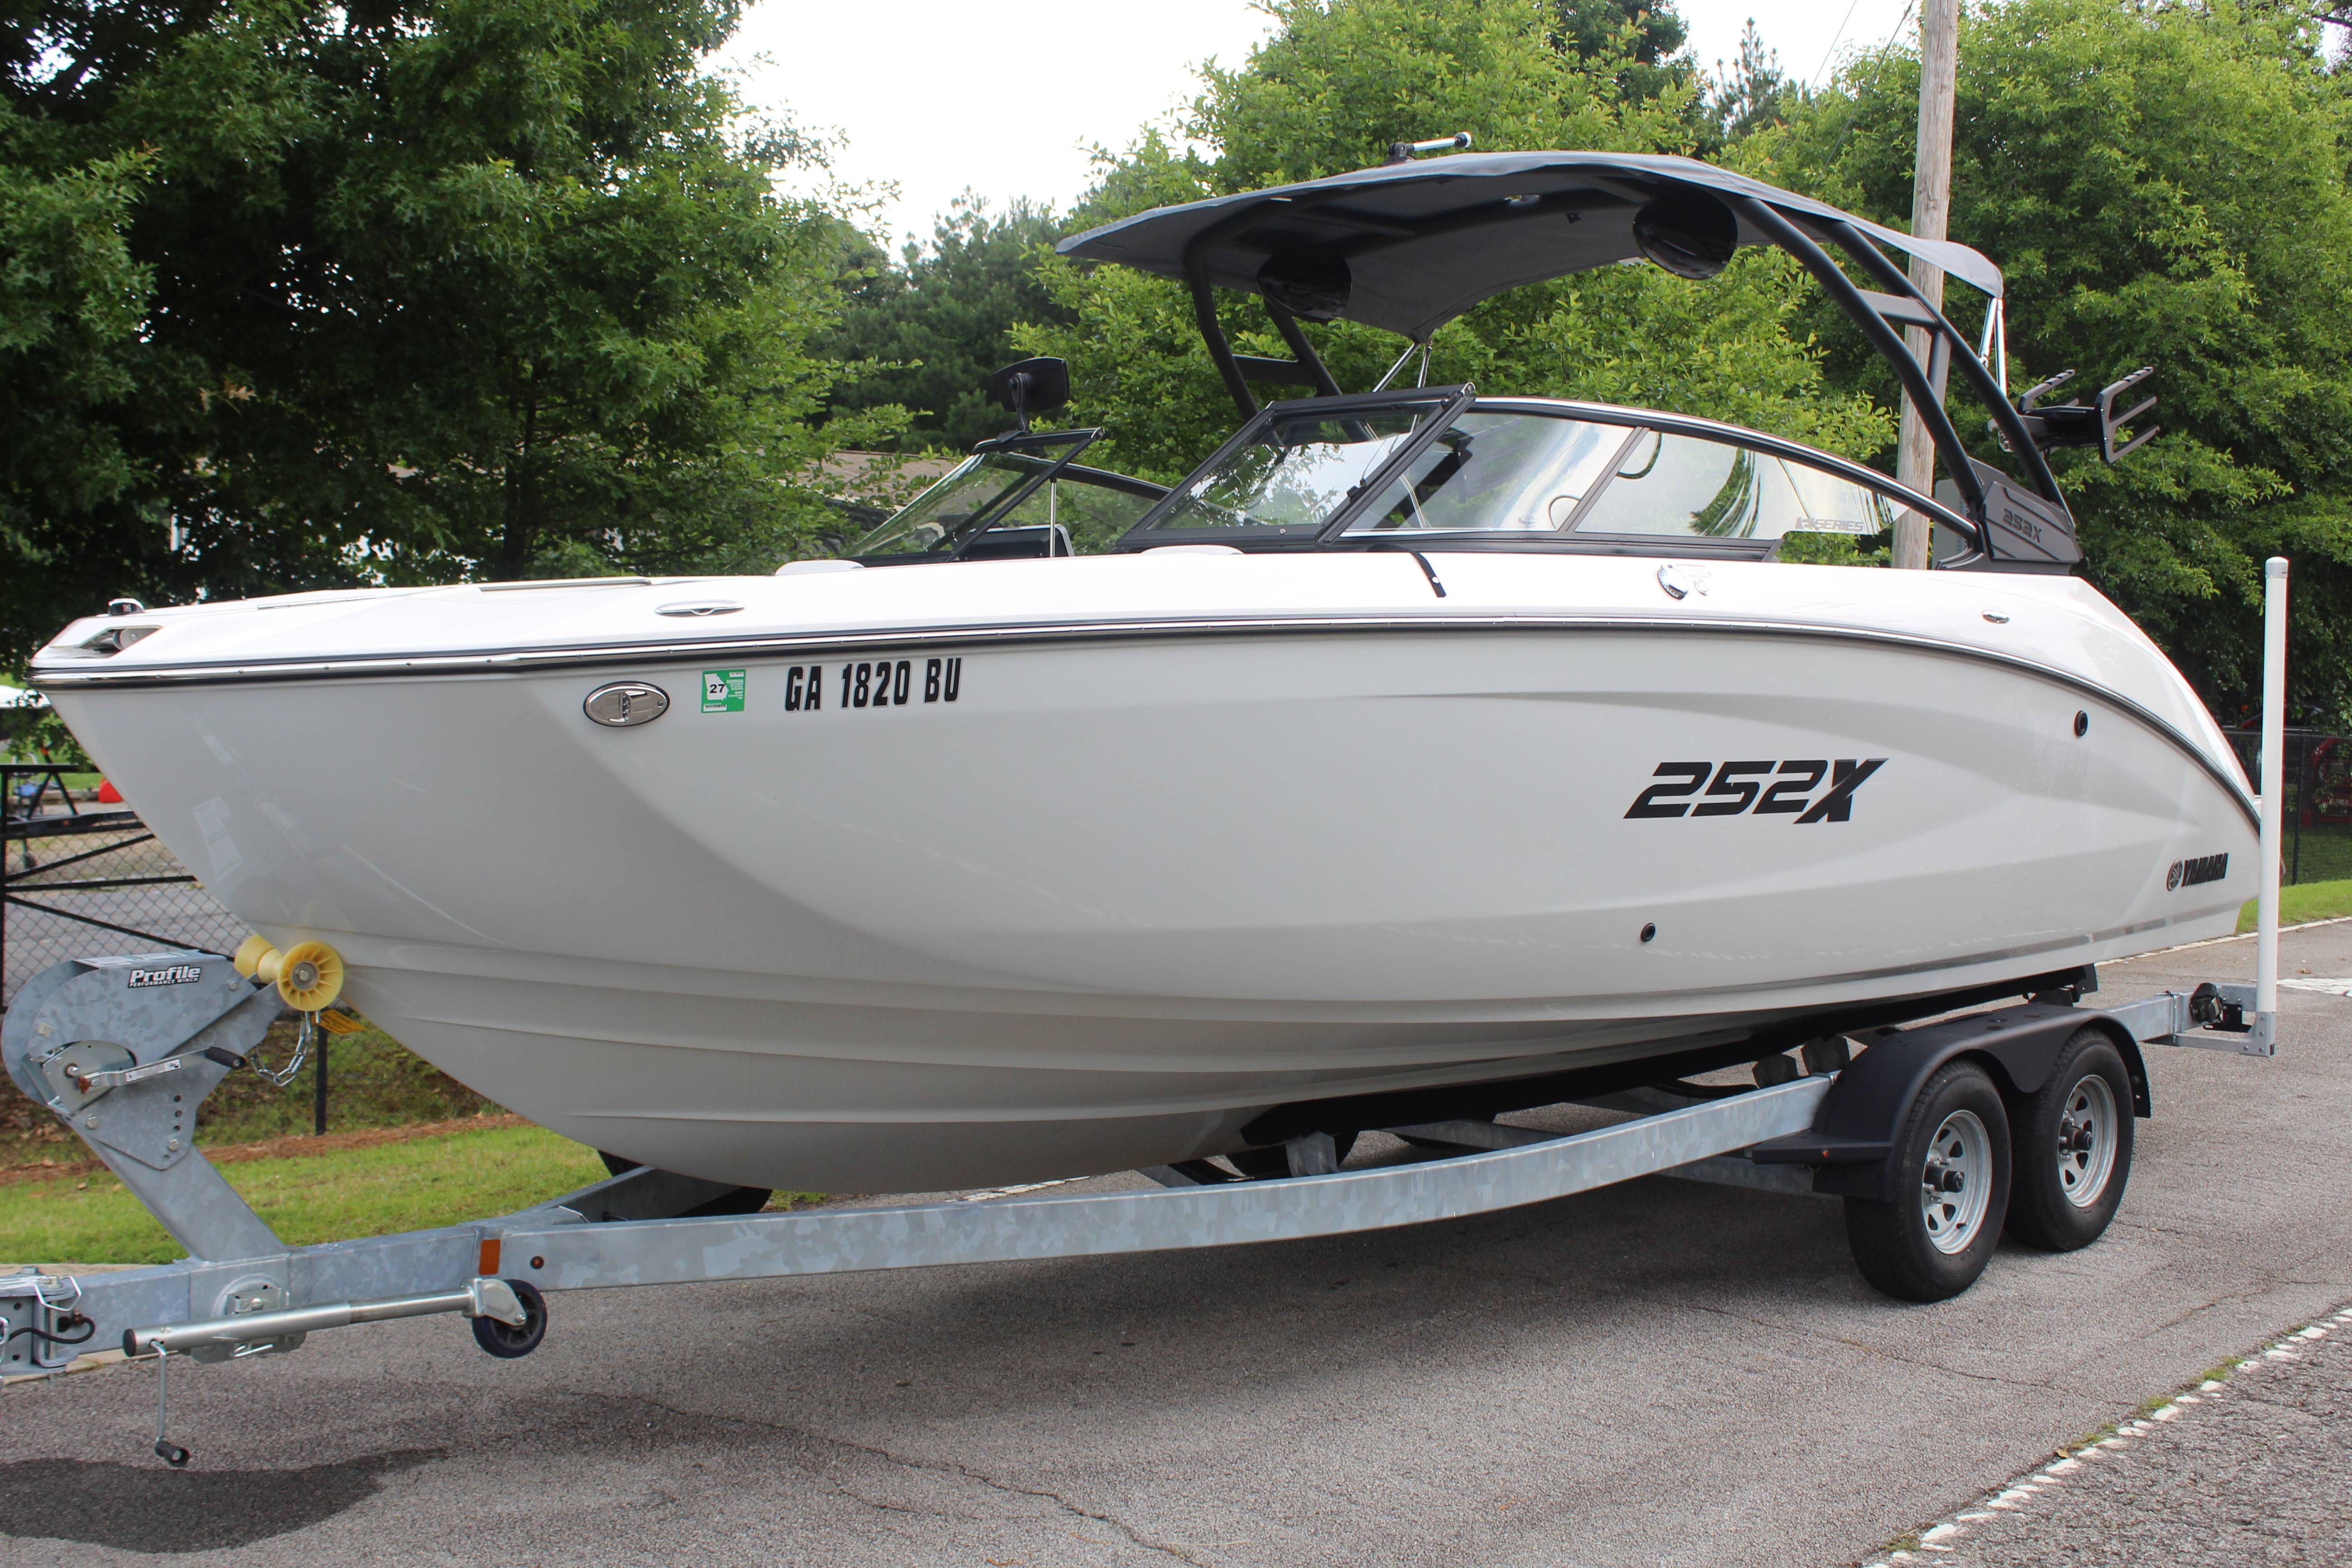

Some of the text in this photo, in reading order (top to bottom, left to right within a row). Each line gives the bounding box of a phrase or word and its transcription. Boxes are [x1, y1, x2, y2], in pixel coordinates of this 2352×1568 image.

[1815, 519, 1863, 532] SERIES
[2003, 508, 2042, 543] 252X
[710, 684, 726, 693] 27
[785, 657, 962, 711] GA 1820 BU
[1623, 758, 1889, 824] 252X
[2181, 853, 2229, 887] YAMAHA
[129, 966, 201, 983] Profile
[129, 979, 176, 988] PERFORMANCE
